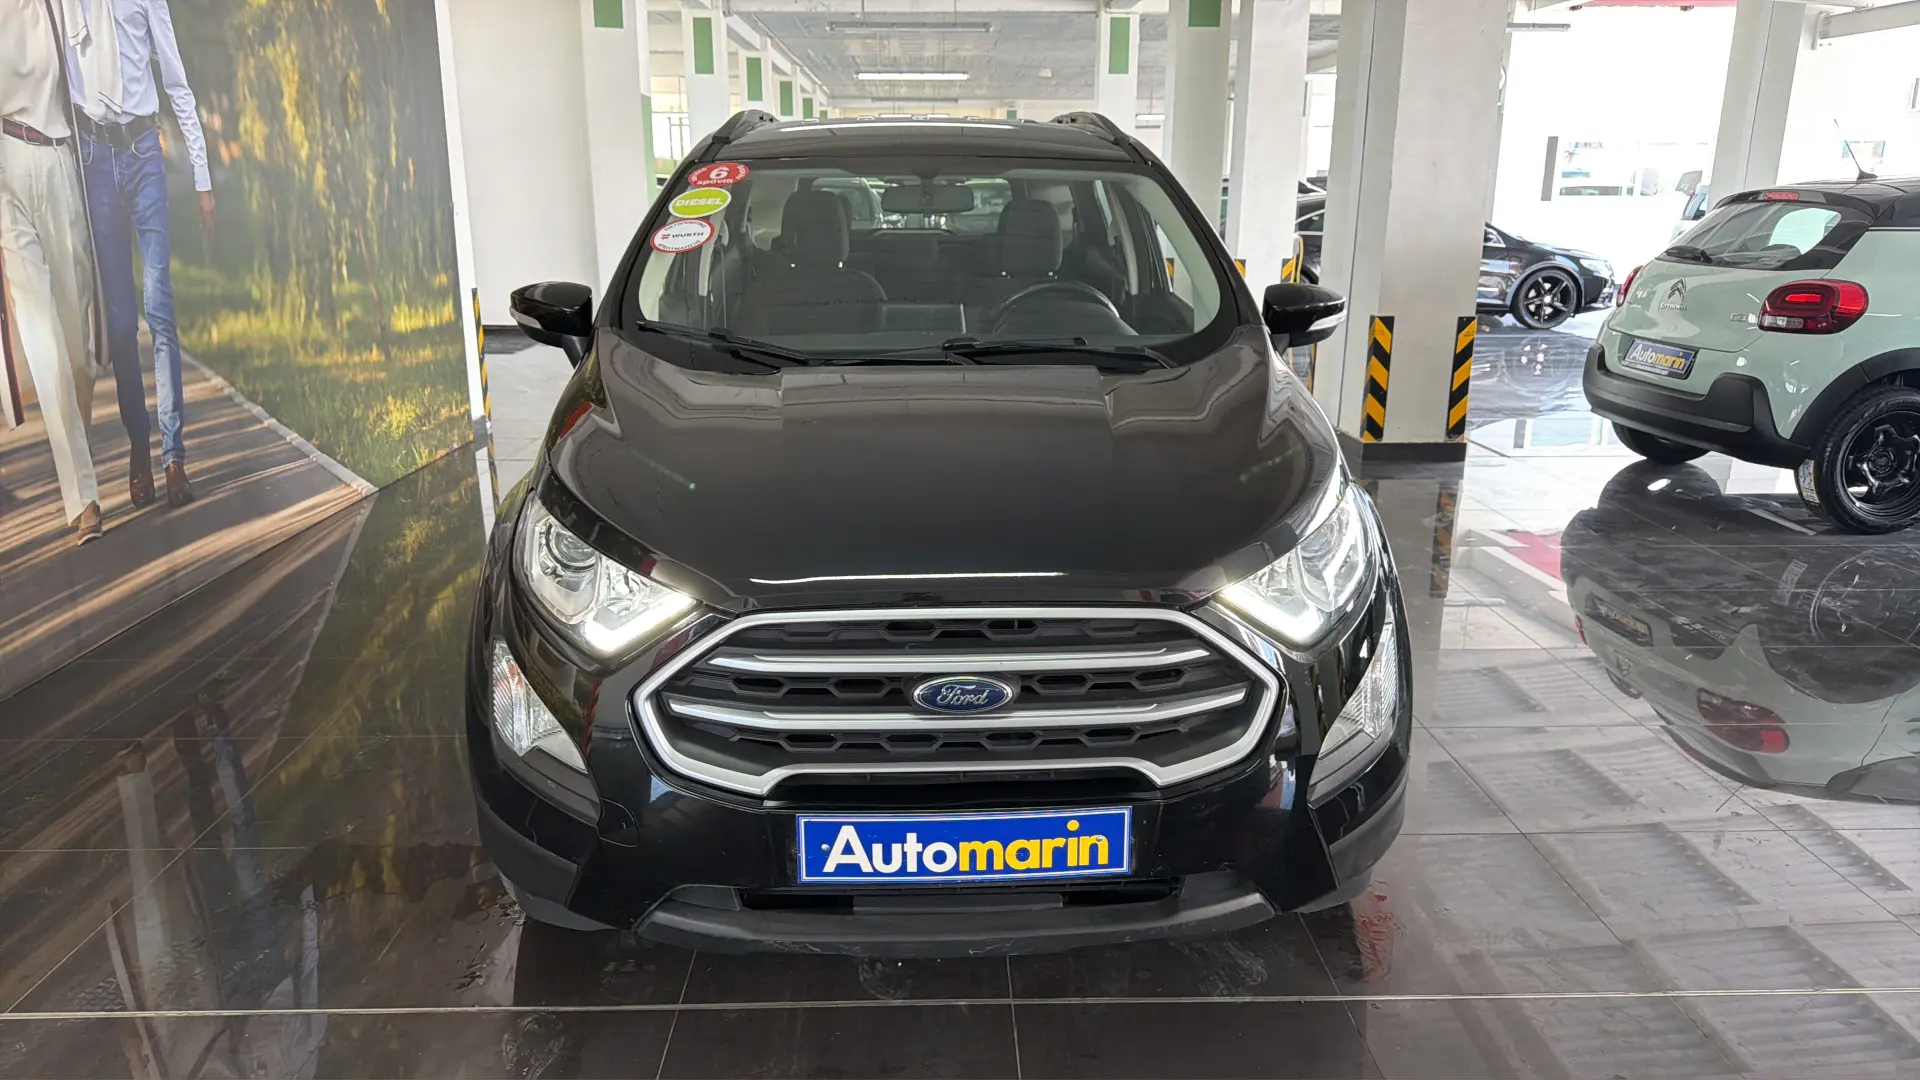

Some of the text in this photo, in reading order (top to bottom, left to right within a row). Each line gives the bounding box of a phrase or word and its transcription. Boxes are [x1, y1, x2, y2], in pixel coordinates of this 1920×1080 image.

[709, 165, 729, 180] 6
[674, 197, 724, 207] DIESEL
[1630, 343, 1685, 369] Automarin
[936, 684, 990, 705] Ford
[822, 819, 1109, 873] Automarin
